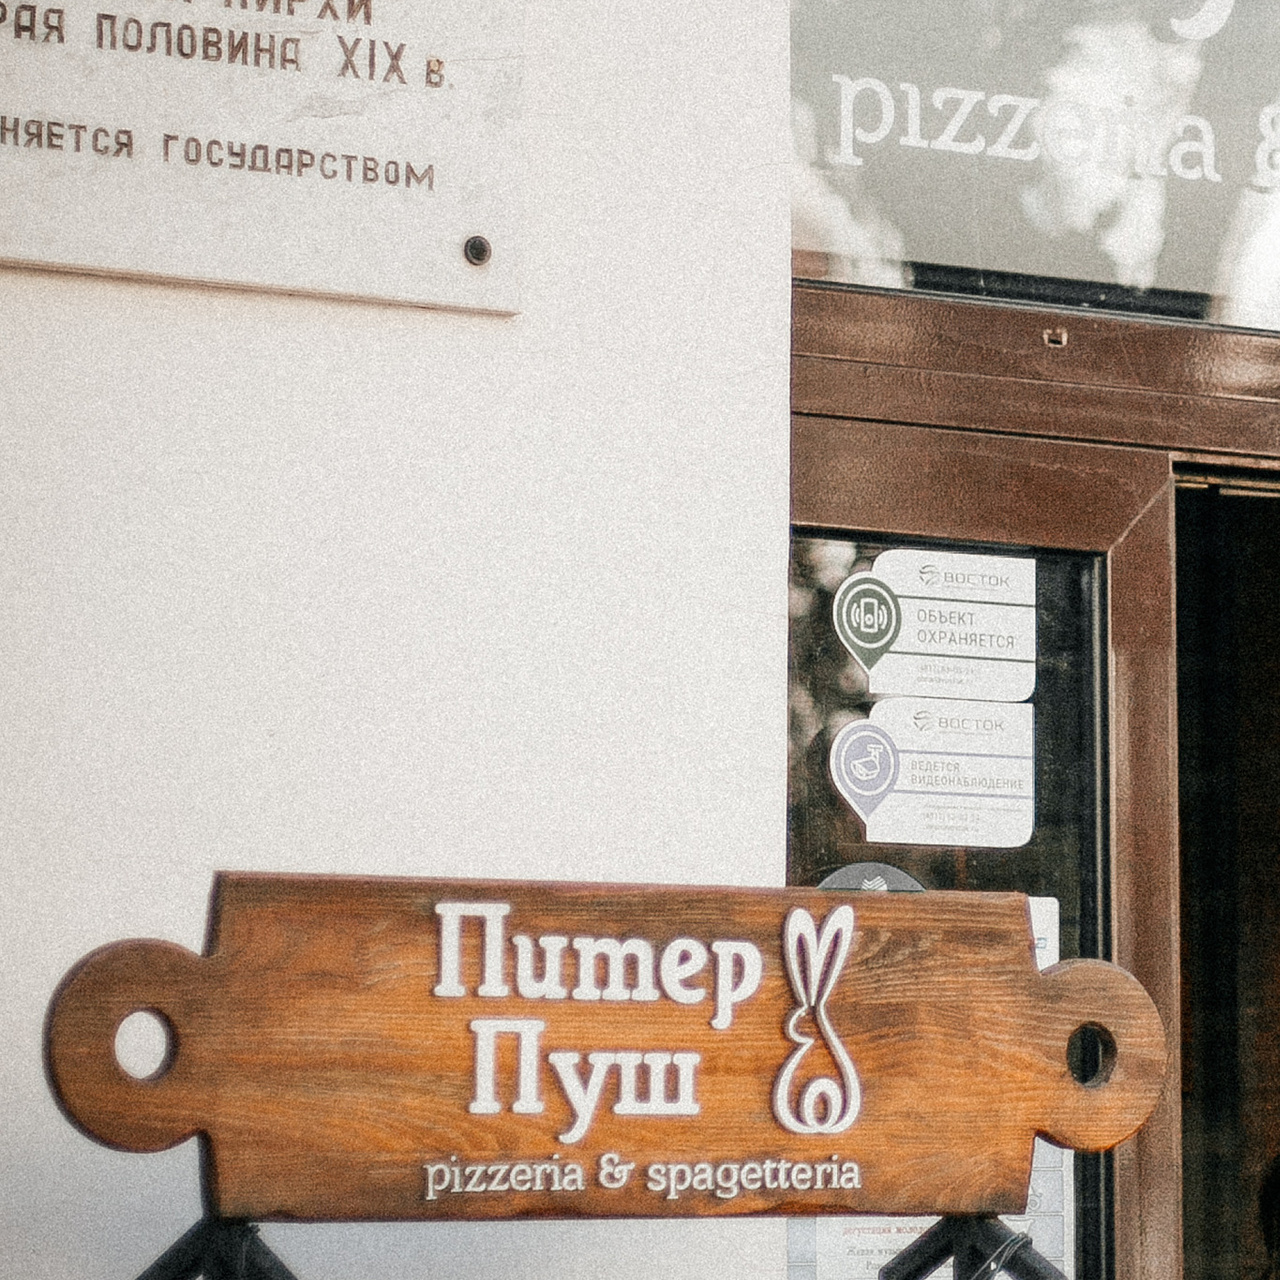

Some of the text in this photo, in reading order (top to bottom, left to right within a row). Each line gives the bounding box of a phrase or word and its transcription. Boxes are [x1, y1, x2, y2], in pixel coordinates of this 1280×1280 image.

[95, 13, 303, 72] ПОЛОВИНА
[162, 132, 436, 192] ГОСУДАРСТВОМ
[943, 571, 1012, 588] ВОСТОК
[917, 608, 976, 626] ОБЪЕКТ
[917, 629, 1015, 649] ОХРАНЯЕТСЯ
[938, 716, 1005, 732] ВОСТОК
[911, 760, 960, 773] ВЕДЕТСЯ
[911, 774, 1025, 790] ВИДЕОНАБЛЮДЕНИЕ
[433, 900, 764, 1031] Питер
[468, 1018, 701, 1145] Пуш
[423, 1152, 863, 1200] pizzeria & spagetteria
